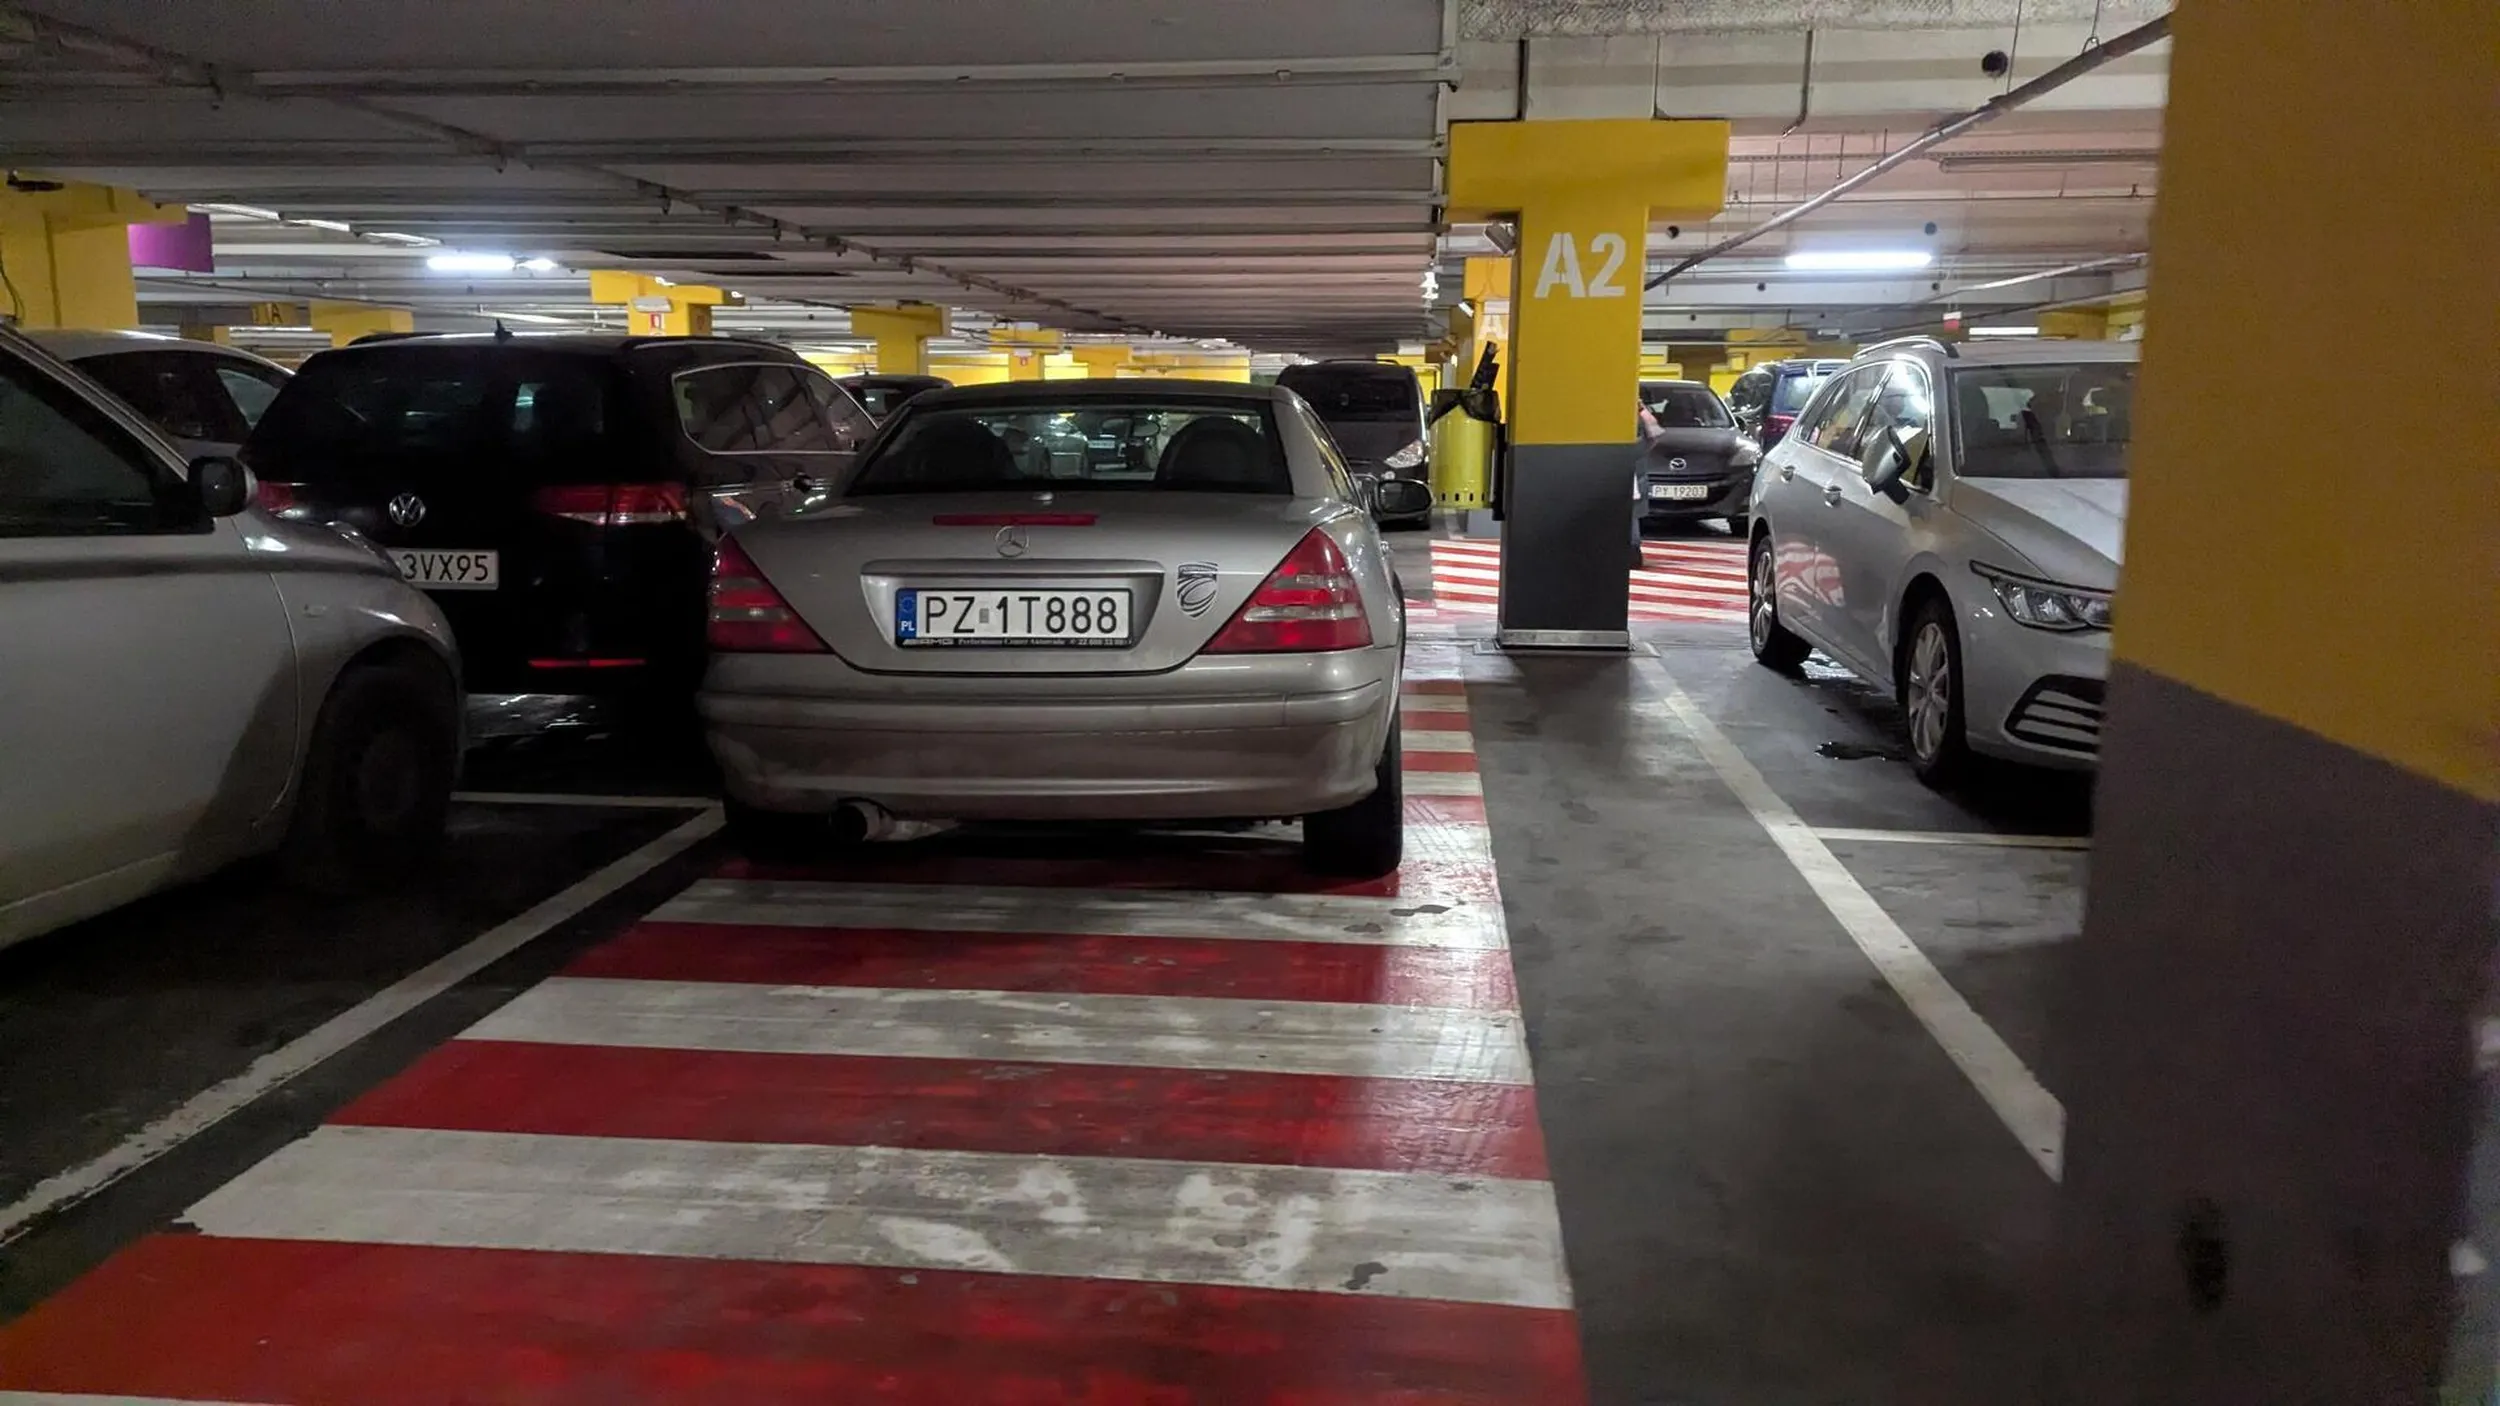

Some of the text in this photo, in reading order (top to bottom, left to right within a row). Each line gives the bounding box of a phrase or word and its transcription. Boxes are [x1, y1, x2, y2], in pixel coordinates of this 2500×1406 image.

[1534, 231, 1626, 299] A2
[402, 553, 488, 581] 3VX95
[901, 621, 915, 632] PL
[925, 596, 1118, 634] PZ 1T888
